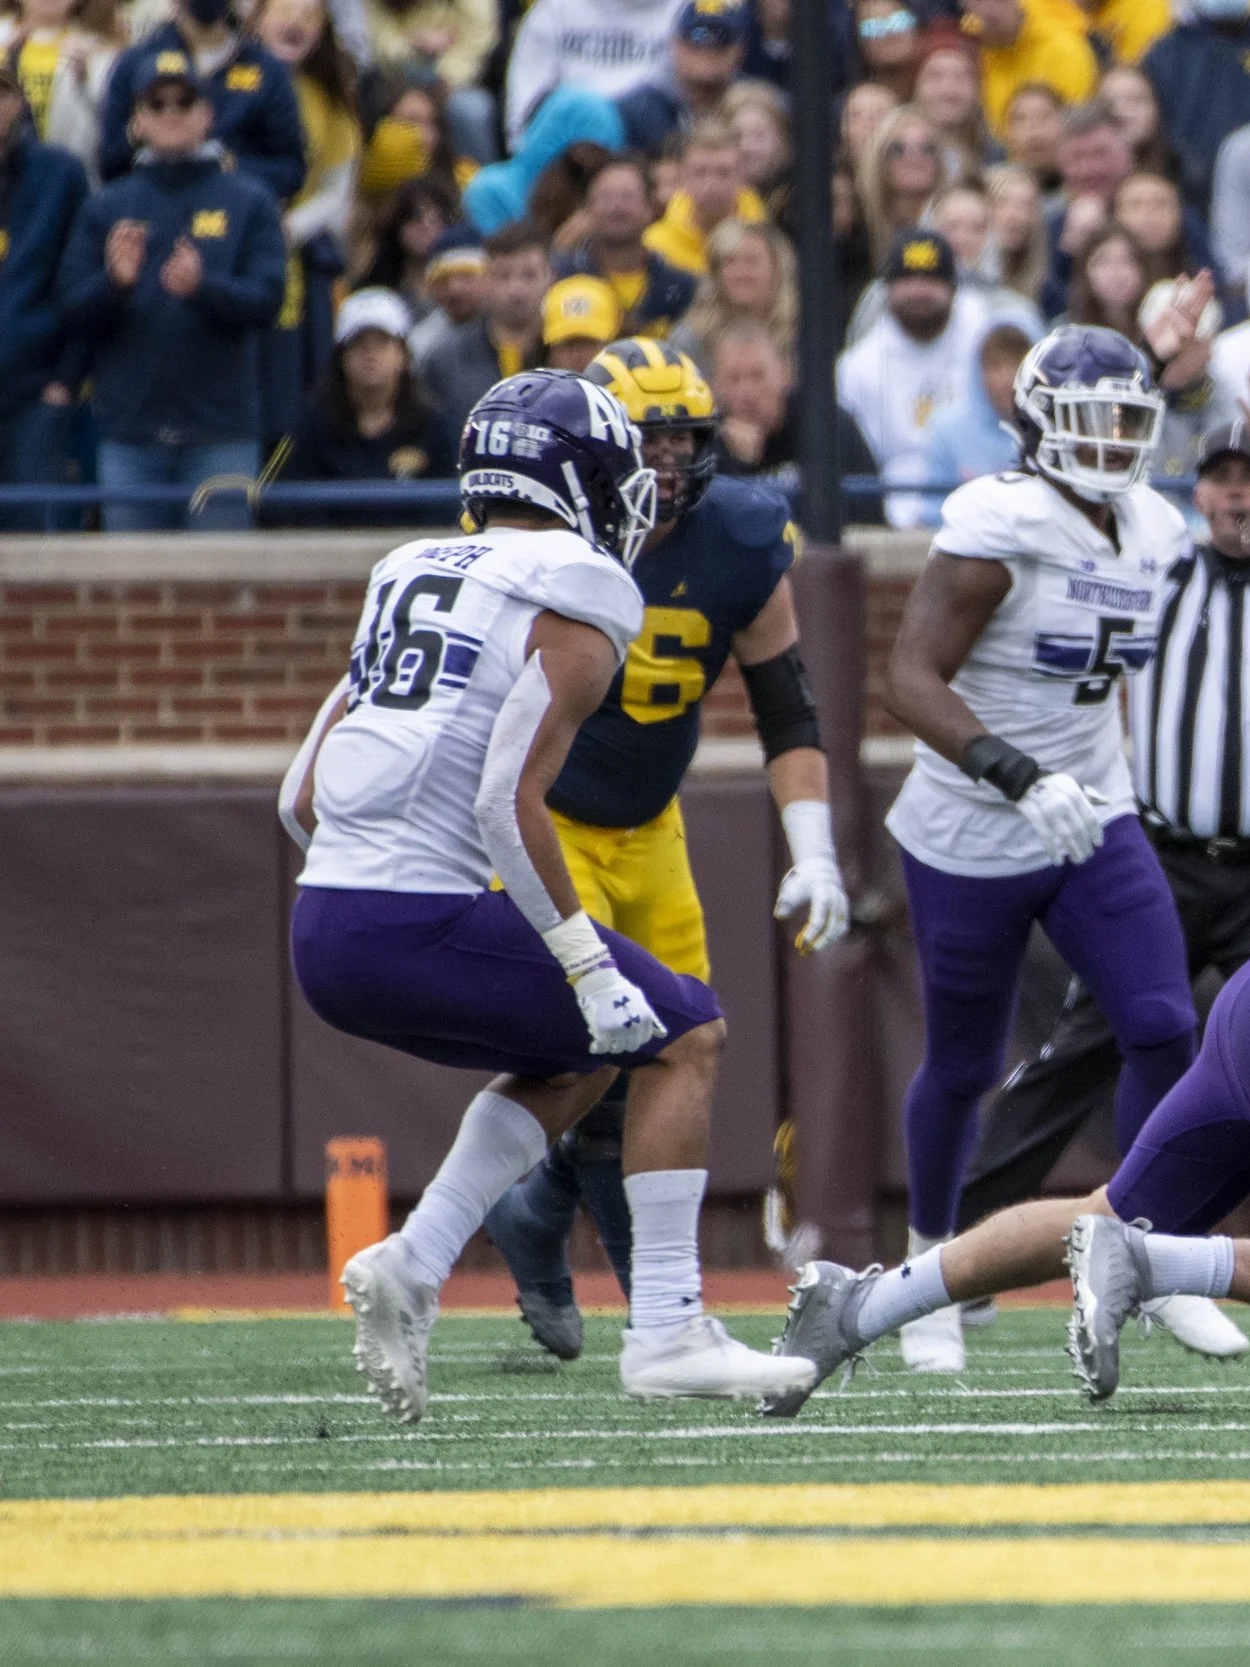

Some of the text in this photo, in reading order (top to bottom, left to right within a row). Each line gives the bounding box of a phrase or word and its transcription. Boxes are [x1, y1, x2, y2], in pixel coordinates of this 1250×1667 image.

[475, 421, 512, 456] 16
[468, 472, 514, 489] WILDCATS
[349, 574, 464, 711] 16
[1073, 617, 1135, 706] 5
